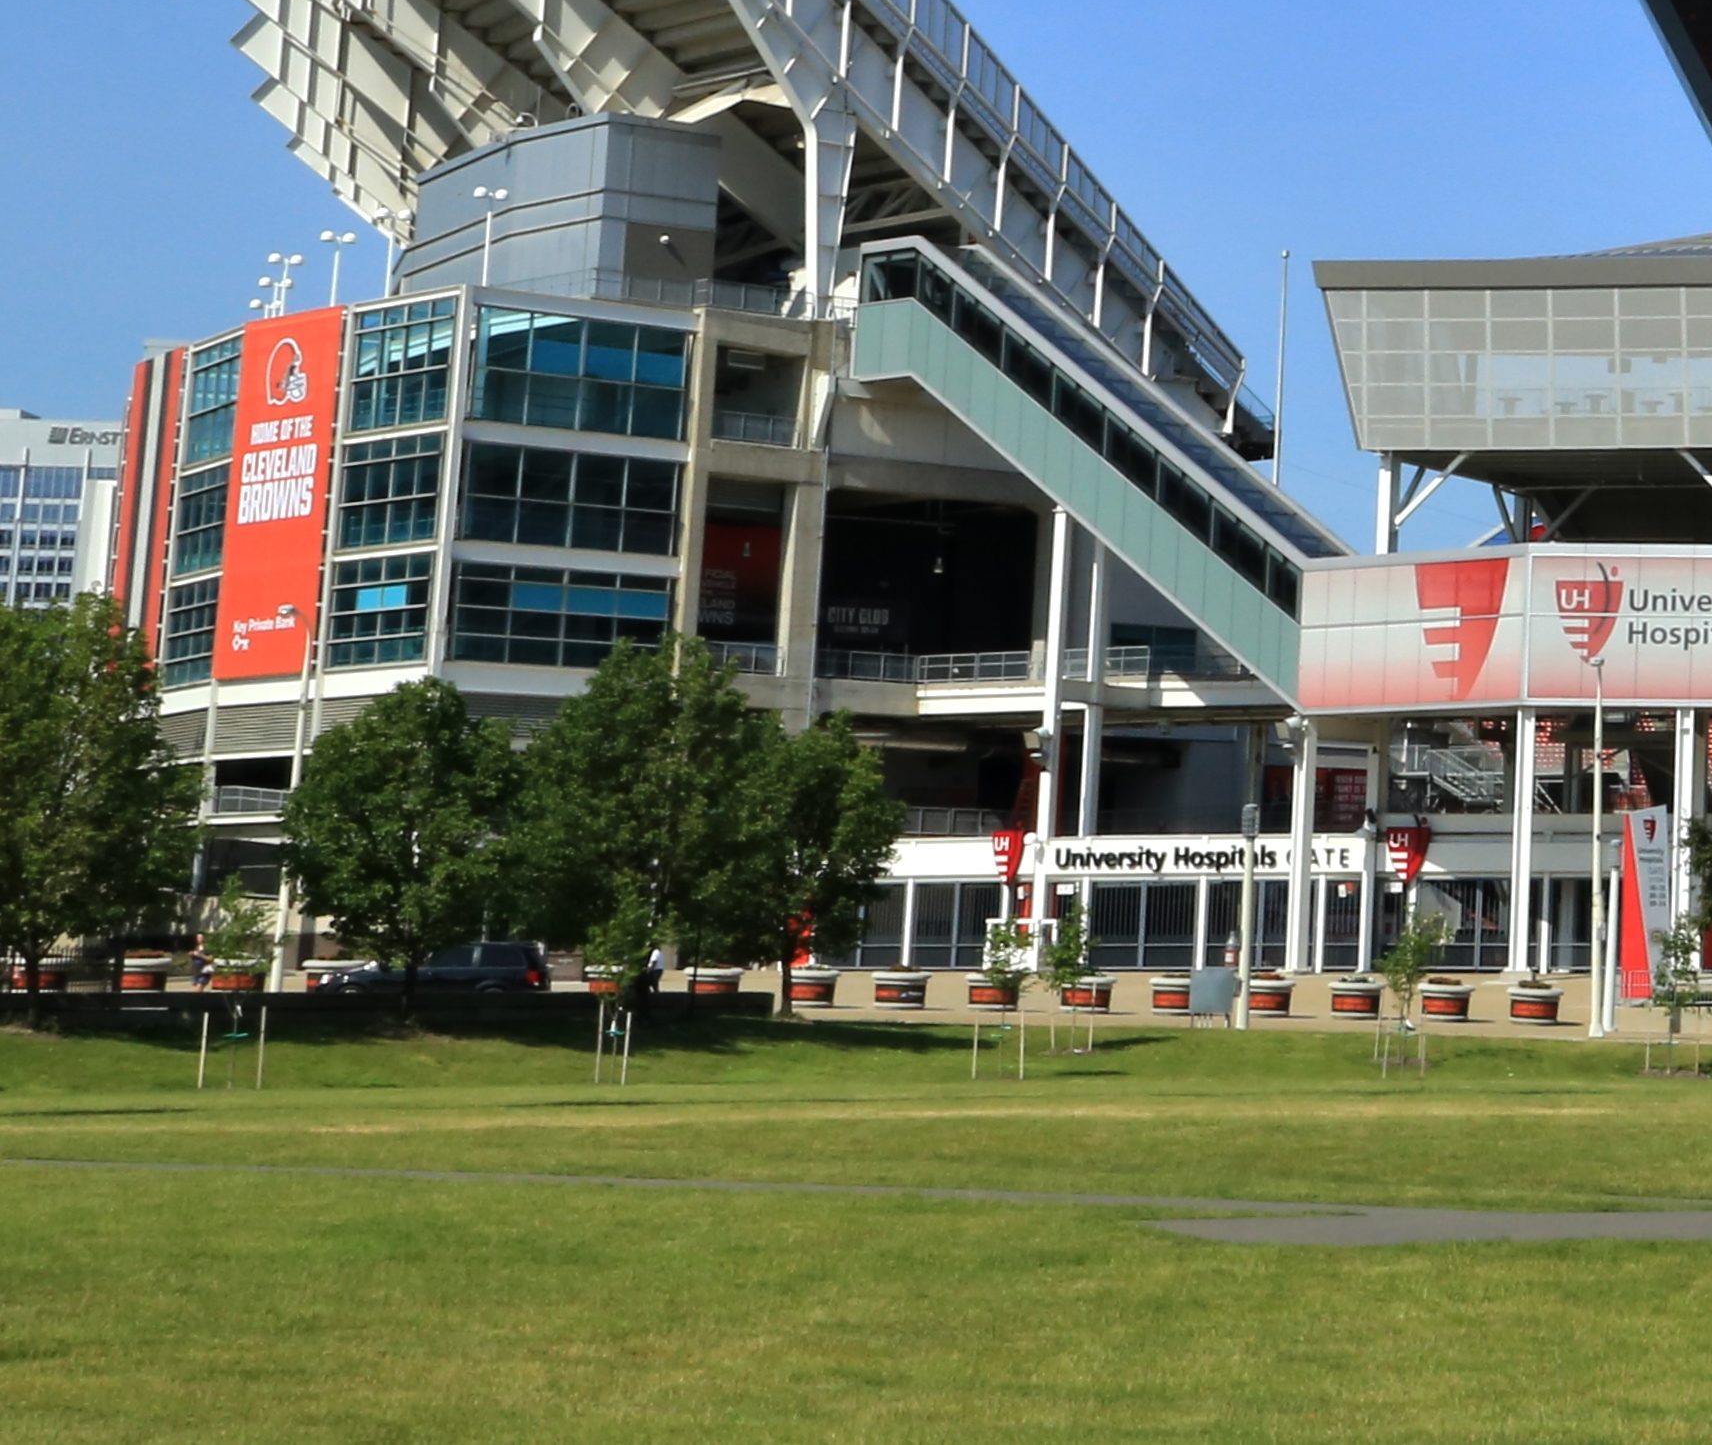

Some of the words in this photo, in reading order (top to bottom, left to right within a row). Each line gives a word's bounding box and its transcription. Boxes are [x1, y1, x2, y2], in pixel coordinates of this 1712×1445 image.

[70, 427, 122, 445] ERNST
[250, 420, 280, 445] HOME
[280, 418, 293, 441] OF
[293, 415, 313, 439] THE
[241, 443, 317, 484] CLEVELAND
[237, 476, 314, 525] BROWNS
[1561, 588, 1590, 610] UH
[827, 606, 856, 624] CITY
[994, 836, 1010, 852] UH
[1389, 833, 1409, 848] UH
[1056, 845, 1167, 873] University
